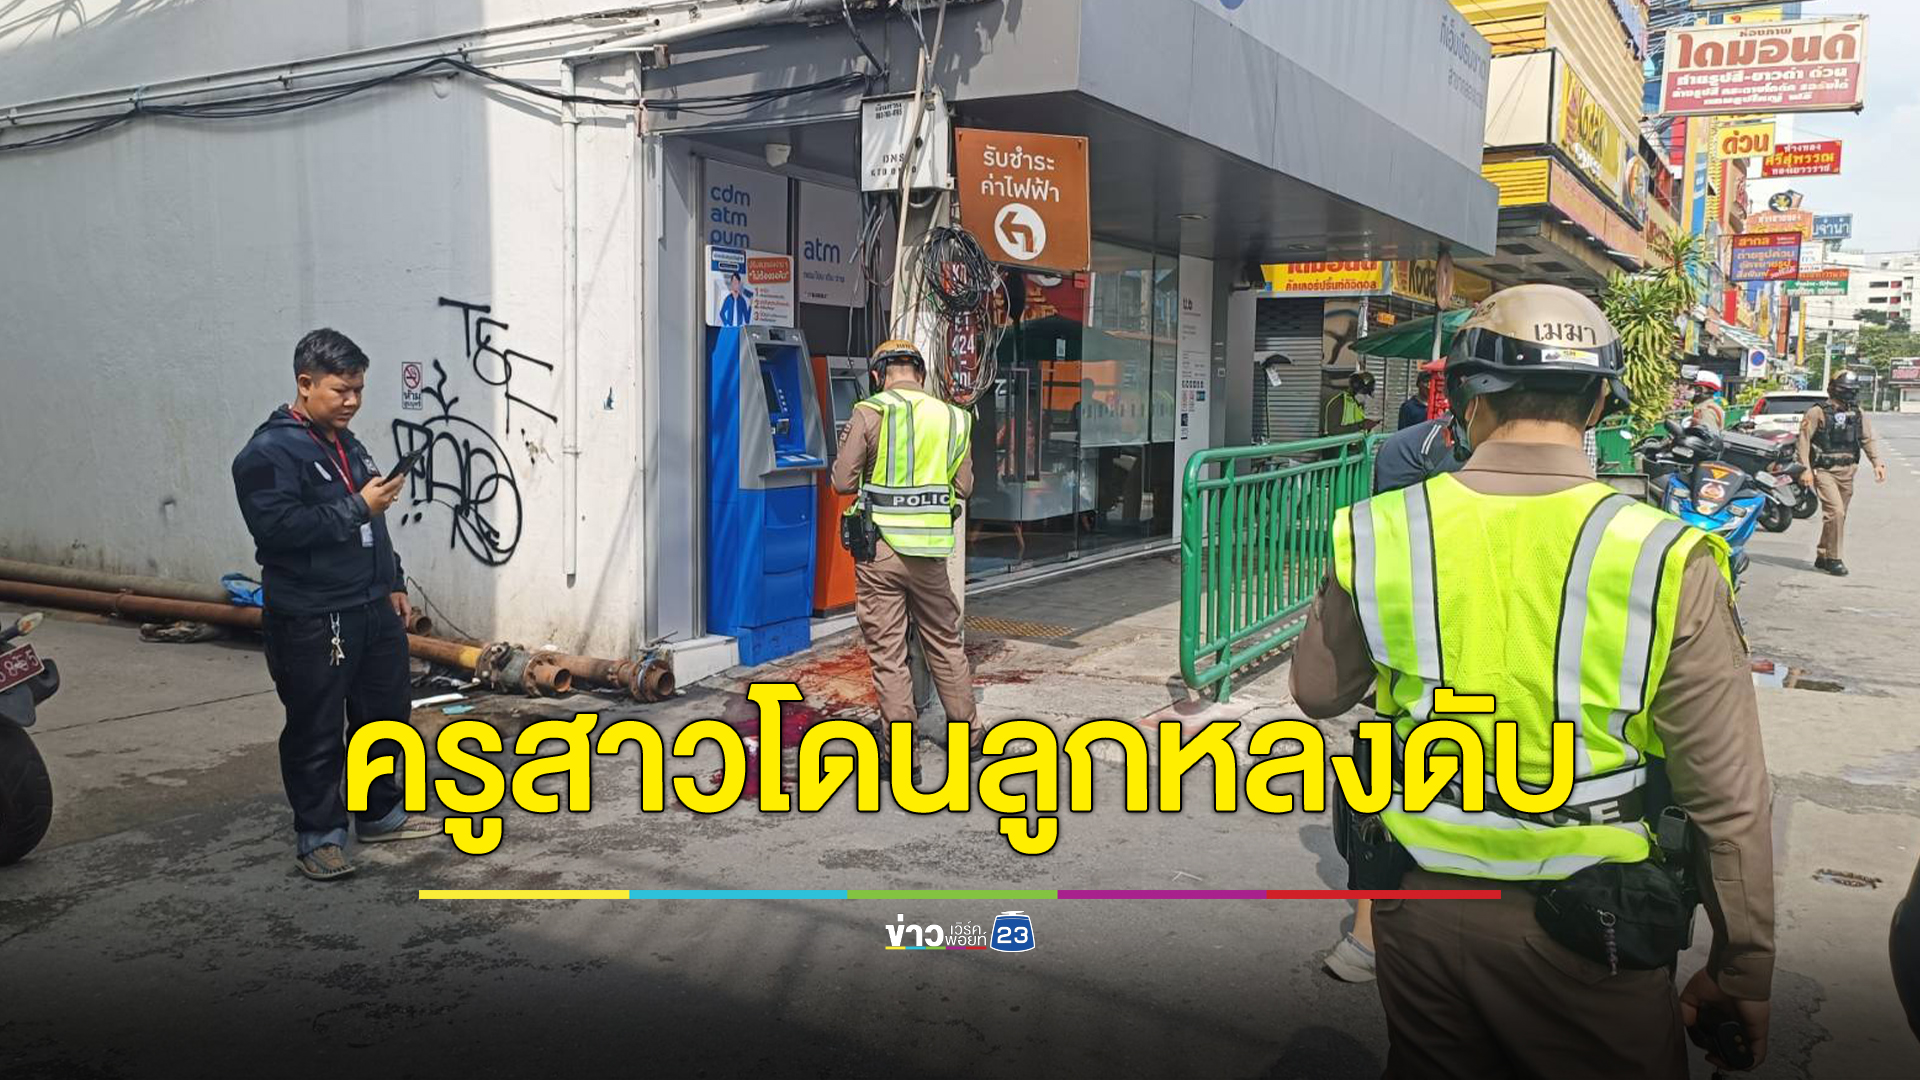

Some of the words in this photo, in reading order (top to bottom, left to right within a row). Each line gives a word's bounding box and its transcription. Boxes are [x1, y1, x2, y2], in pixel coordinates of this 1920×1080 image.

[1678, 24, 1861, 69] ไดมอนด์
[1721, 129, 1770, 155] ด่วน
[983, 144, 1055, 171] รับชำระ
[711, 185, 750, 206] cdm
[981, 173, 1060, 203] ค่าไฟฟ้า
[711, 207, 747, 227] atm
[804, 238, 840, 264] atm
